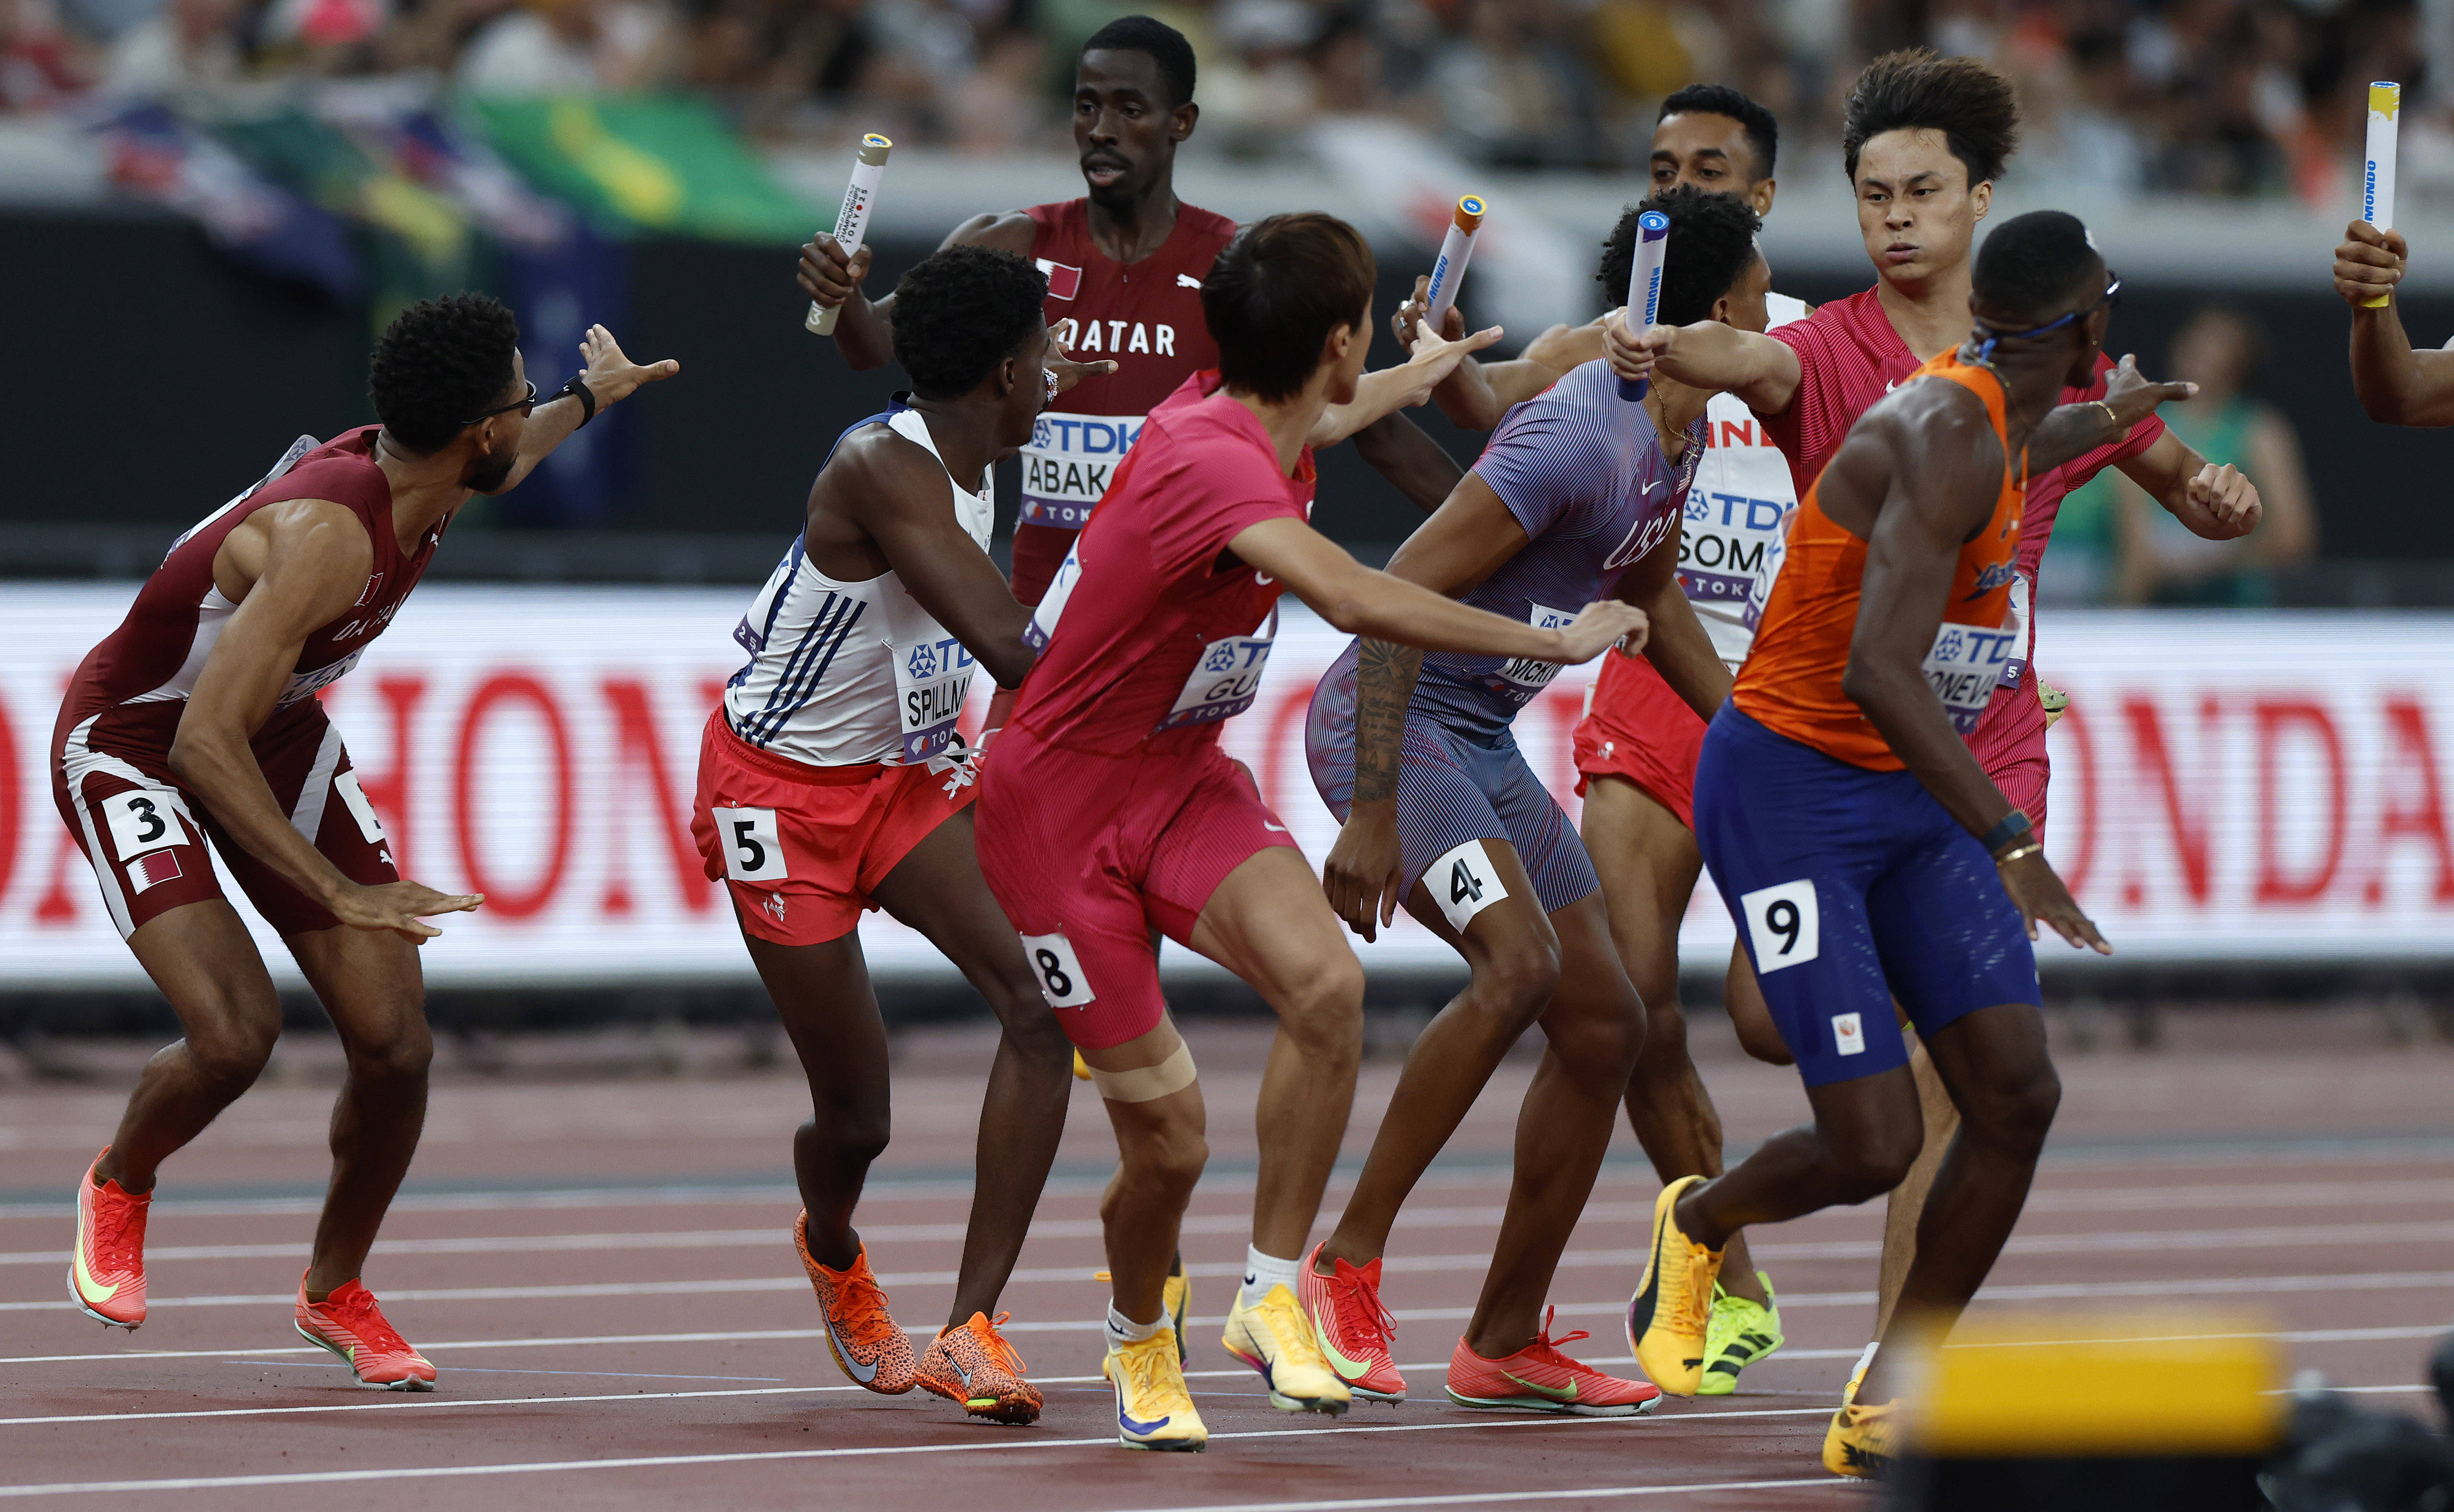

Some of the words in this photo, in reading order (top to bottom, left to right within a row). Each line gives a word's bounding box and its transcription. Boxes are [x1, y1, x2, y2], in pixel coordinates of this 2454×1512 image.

[2365, 160, 2376, 221] MONDO
[839, 187, 861, 243] CHAMPIONSHIPS
[1429, 255, 1449, 300] MONDO
[1644, 276, 1660, 325] MONDO
[1057, 318, 1175, 357] QATAR
[1051, 419, 1144, 454] TDK
[1029, 457, 1107, 495] ABAK
[1046, 505, 1091, 522] TOK
[1711, 492, 1793, 531] TD
[1679, 530, 1764, 573] SOM
[1695, 577, 1744, 596] TOK
[936, 638, 975, 672] TD
[1968, 631, 2017, 664] TD
[907, 673, 973, 727] SPILLM
[1205, 670, 1260, 701] GU
[1504, 688, 1536, 703] TOK
[1195, 701, 1247, 719] TOKY
[932, 727, 956, 747] TOK
[127, 797, 166, 843] 3
[734, 821, 765, 871] 5
[1451, 858, 1483, 905] 4
[1766, 900, 1800, 955] 9
[1036, 949, 1072, 997] 8
